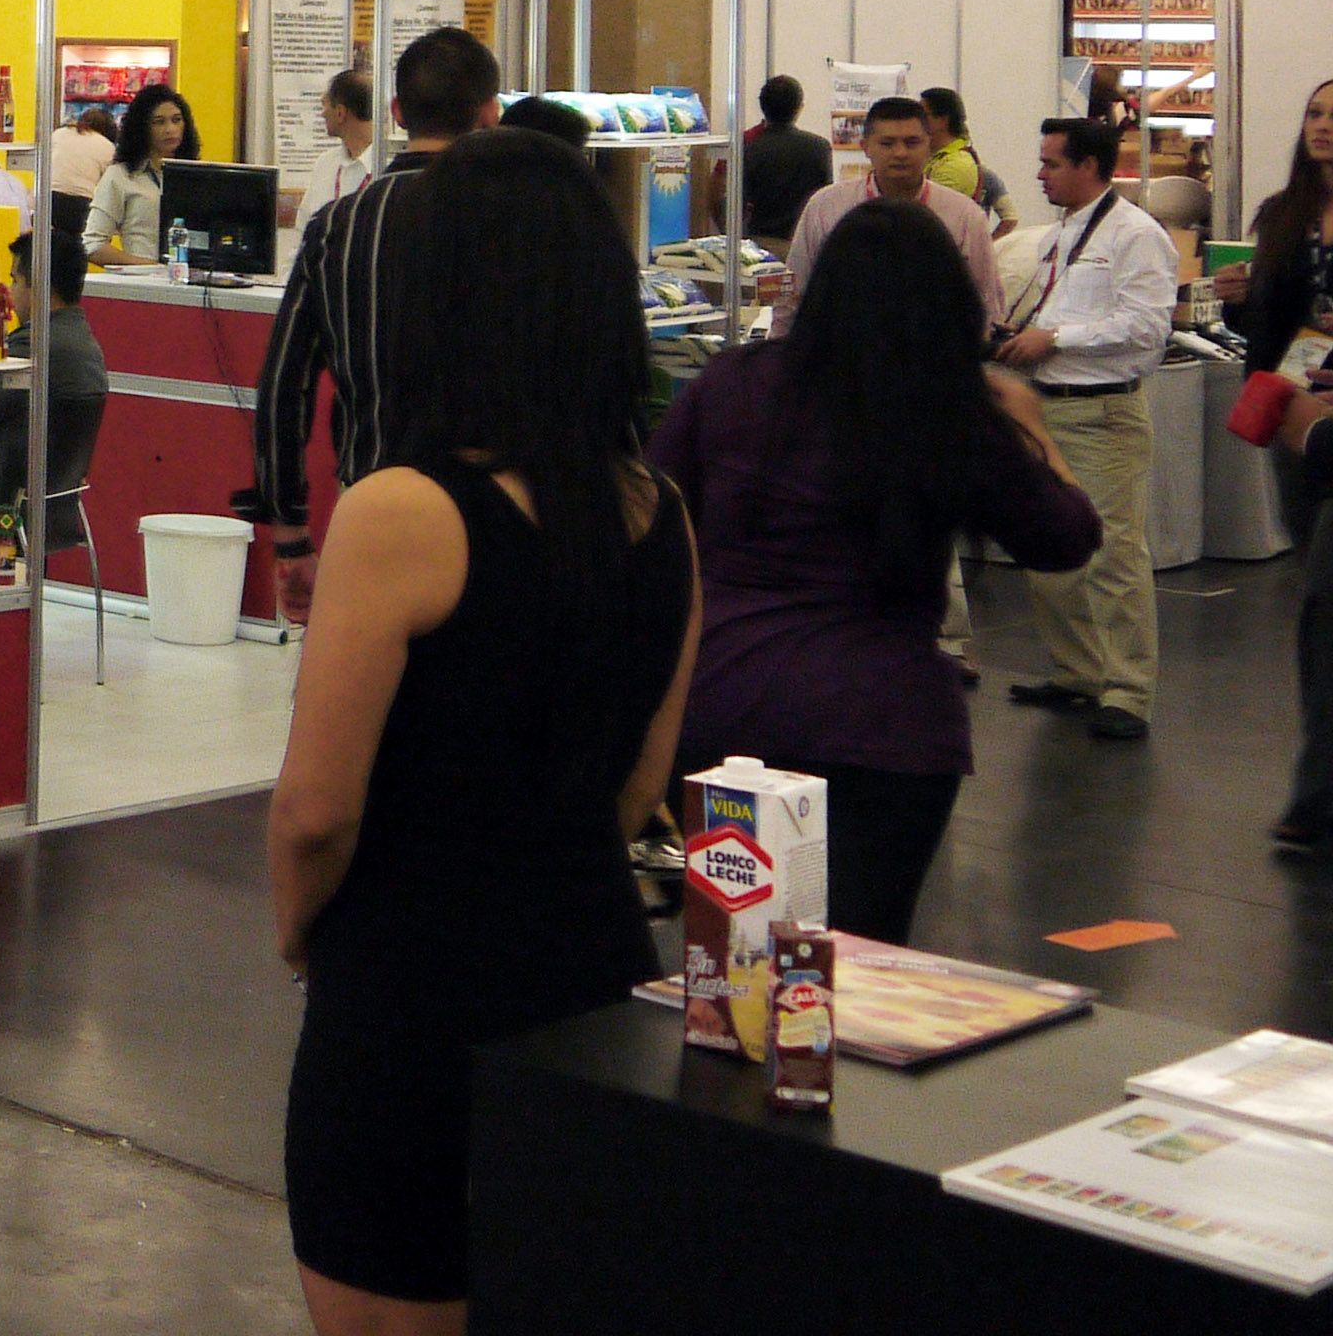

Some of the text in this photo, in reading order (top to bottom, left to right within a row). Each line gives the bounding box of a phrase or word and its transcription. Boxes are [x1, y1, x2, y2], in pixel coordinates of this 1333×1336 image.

[711, 798, 755, 824] VIDA
[706, 850, 757, 872] LONCO
[706, 864, 757, 886] LECHE
